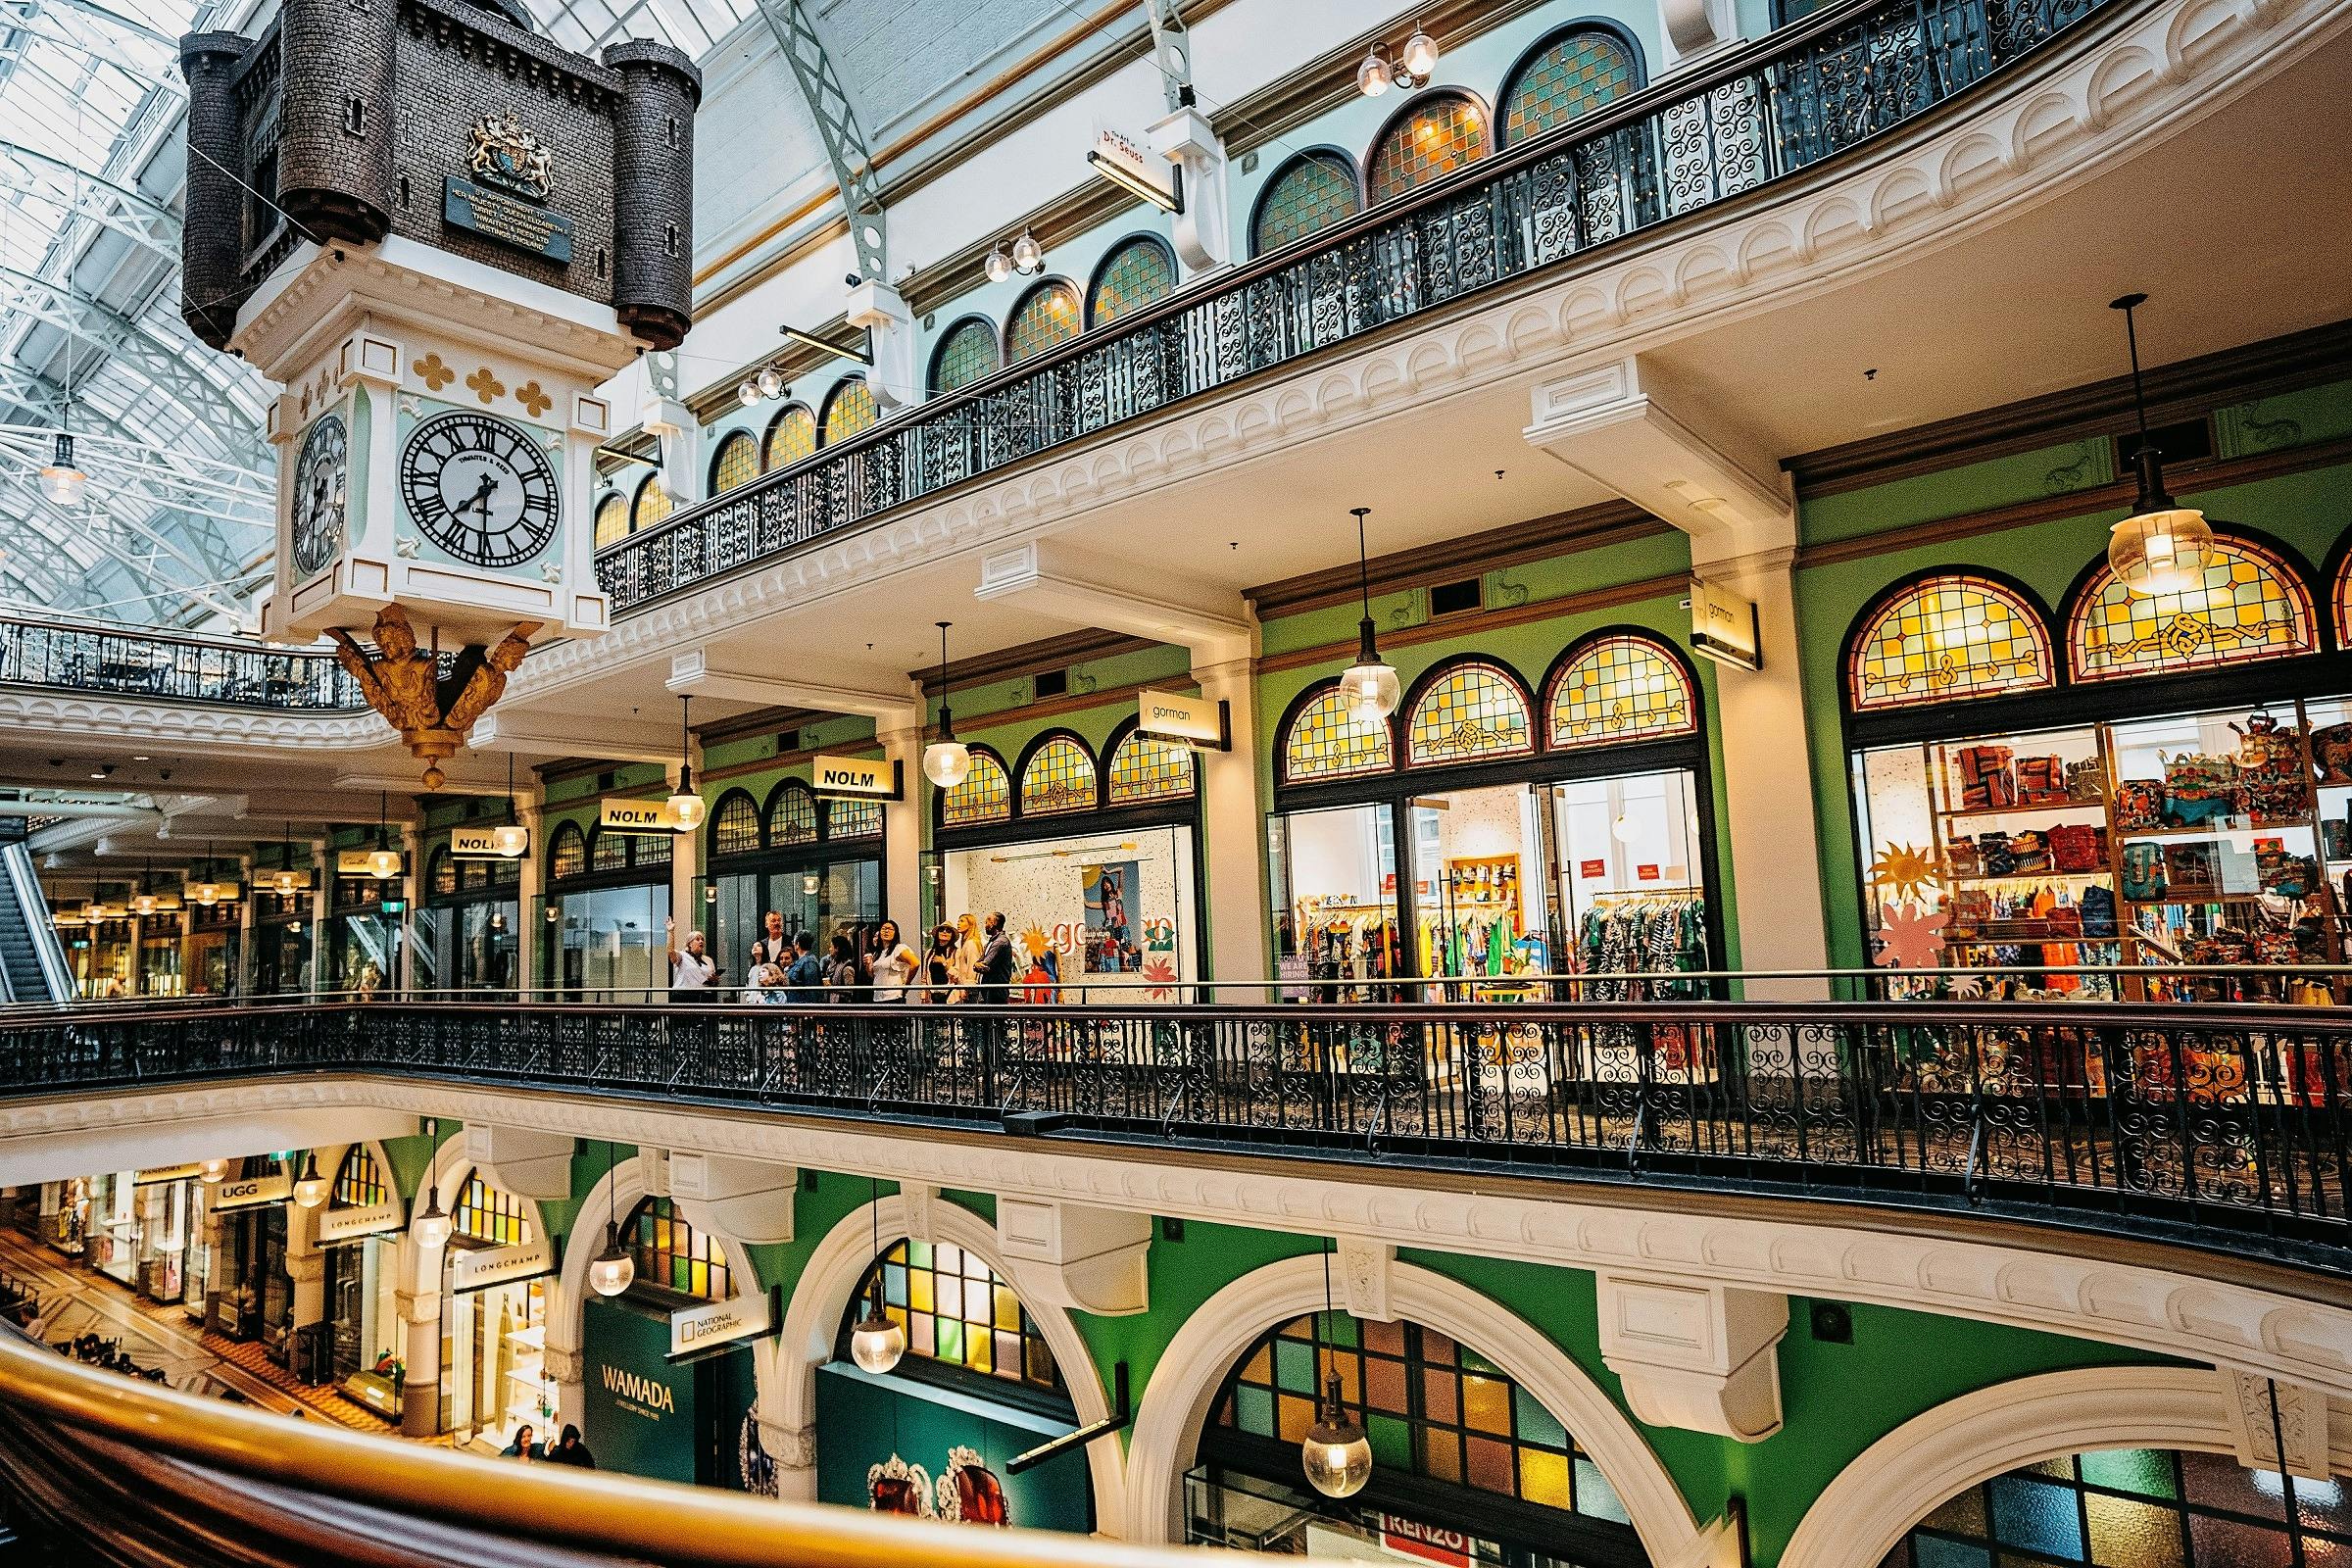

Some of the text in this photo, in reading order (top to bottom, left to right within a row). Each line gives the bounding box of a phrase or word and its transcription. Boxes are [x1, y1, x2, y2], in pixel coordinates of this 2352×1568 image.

[1102, 130, 1116, 147] Dr.
[1119, 141, 1144, 164] Seuss
[1120, 134, 1129, 144] Art
[452, 188, 466, 199] HER
[468, 195, 501, 211] MAJESTY
[503, 207, 526, 220] QUEEN
[527, 216, 564, 233] ELIZABETH
[475, 188, 546, 220] BY APPOINTMENT TO
[470, 204, 550, 236] TURRET CLOCKMAKERS
[472, 213, 508, 229] THWAITES
[516, 228, 534, 239] REED
[536, 234, 549, 244] LTD
[475, 222, 544, 251] HASTINGS ENGLAND
[441, 426, 466, 454] XI
[473, 425, 496, 453] XII
[421, 441, 447, 466] X
[504, 440, 522, 461] I
[496, 462, 510, 475] REED
[520, 467, 543, 483] II
[526, 494, 550, 513] III
[1709, 603, 1735, 624] gorman
[1153, 707, 1190, 720] gorman
[823, 769, 875, 787] NOLM
[609, 810, 658, 823] NOLM
[222, 1184, 258, 1198] UGG
[331, 1213, 392, 1228] LONGCHAMP
[474, 1254, 540, 1274] LONGCHAMP
[697, 1319, 743, 1338] GEOGRAPHIC
[698, 1313, 732, 1327] NATIONAL
[602, 1364, 674, 1414] WAMADA
[1389, 1515, 1463, 1549] KENZO
